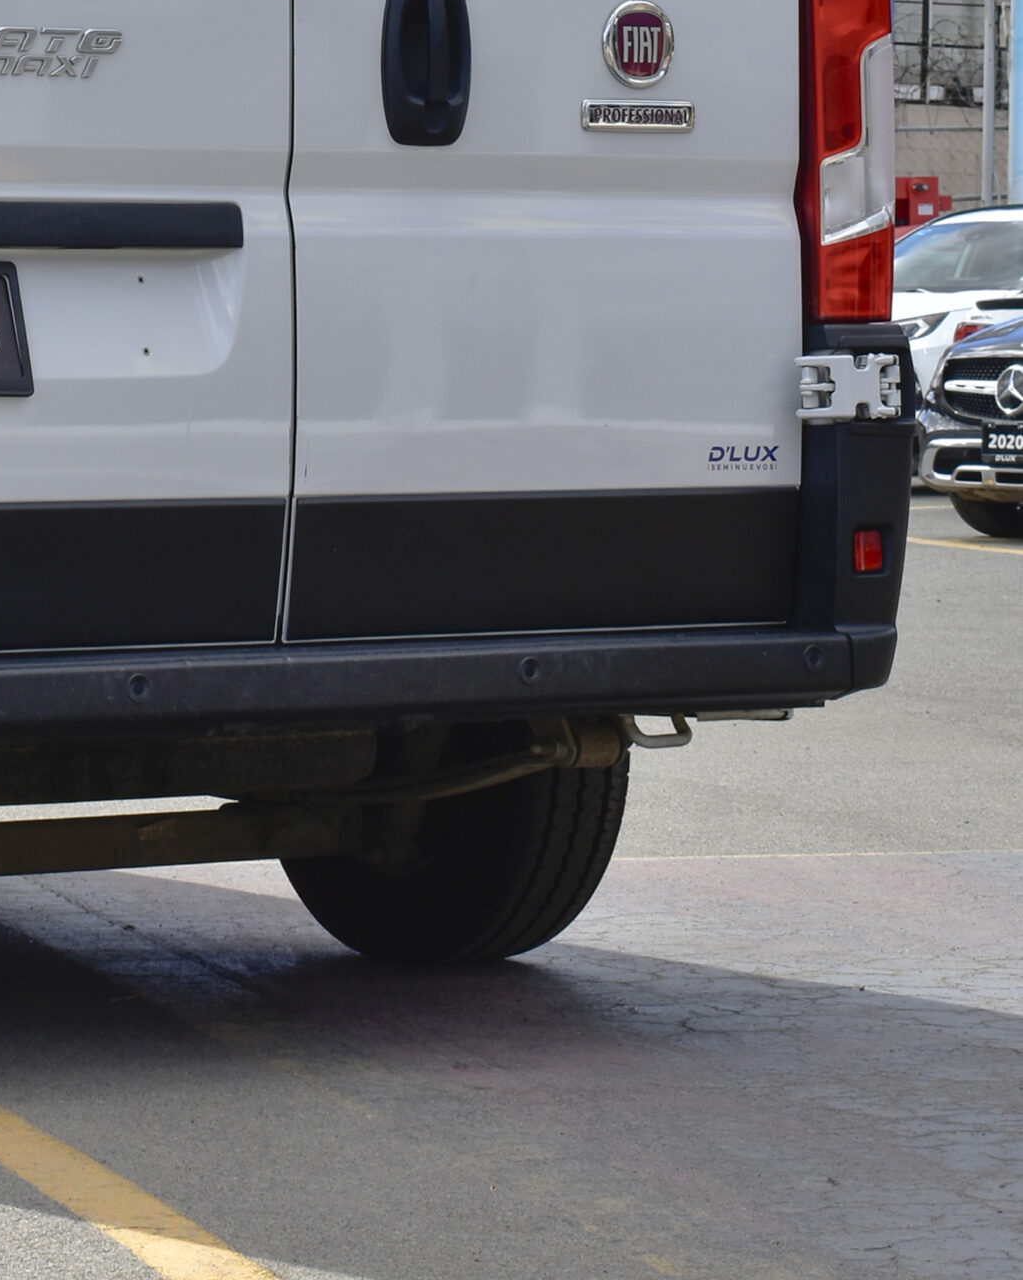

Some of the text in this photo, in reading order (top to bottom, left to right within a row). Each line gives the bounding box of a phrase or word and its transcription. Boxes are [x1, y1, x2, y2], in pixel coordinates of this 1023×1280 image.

[622, 26, 661, 63] FIAT
[593, 108, 689, 124] PROFESSIONAL
[988, 433, 1023, 450] 2020
[708, 445, 779, 462] D'LUX
